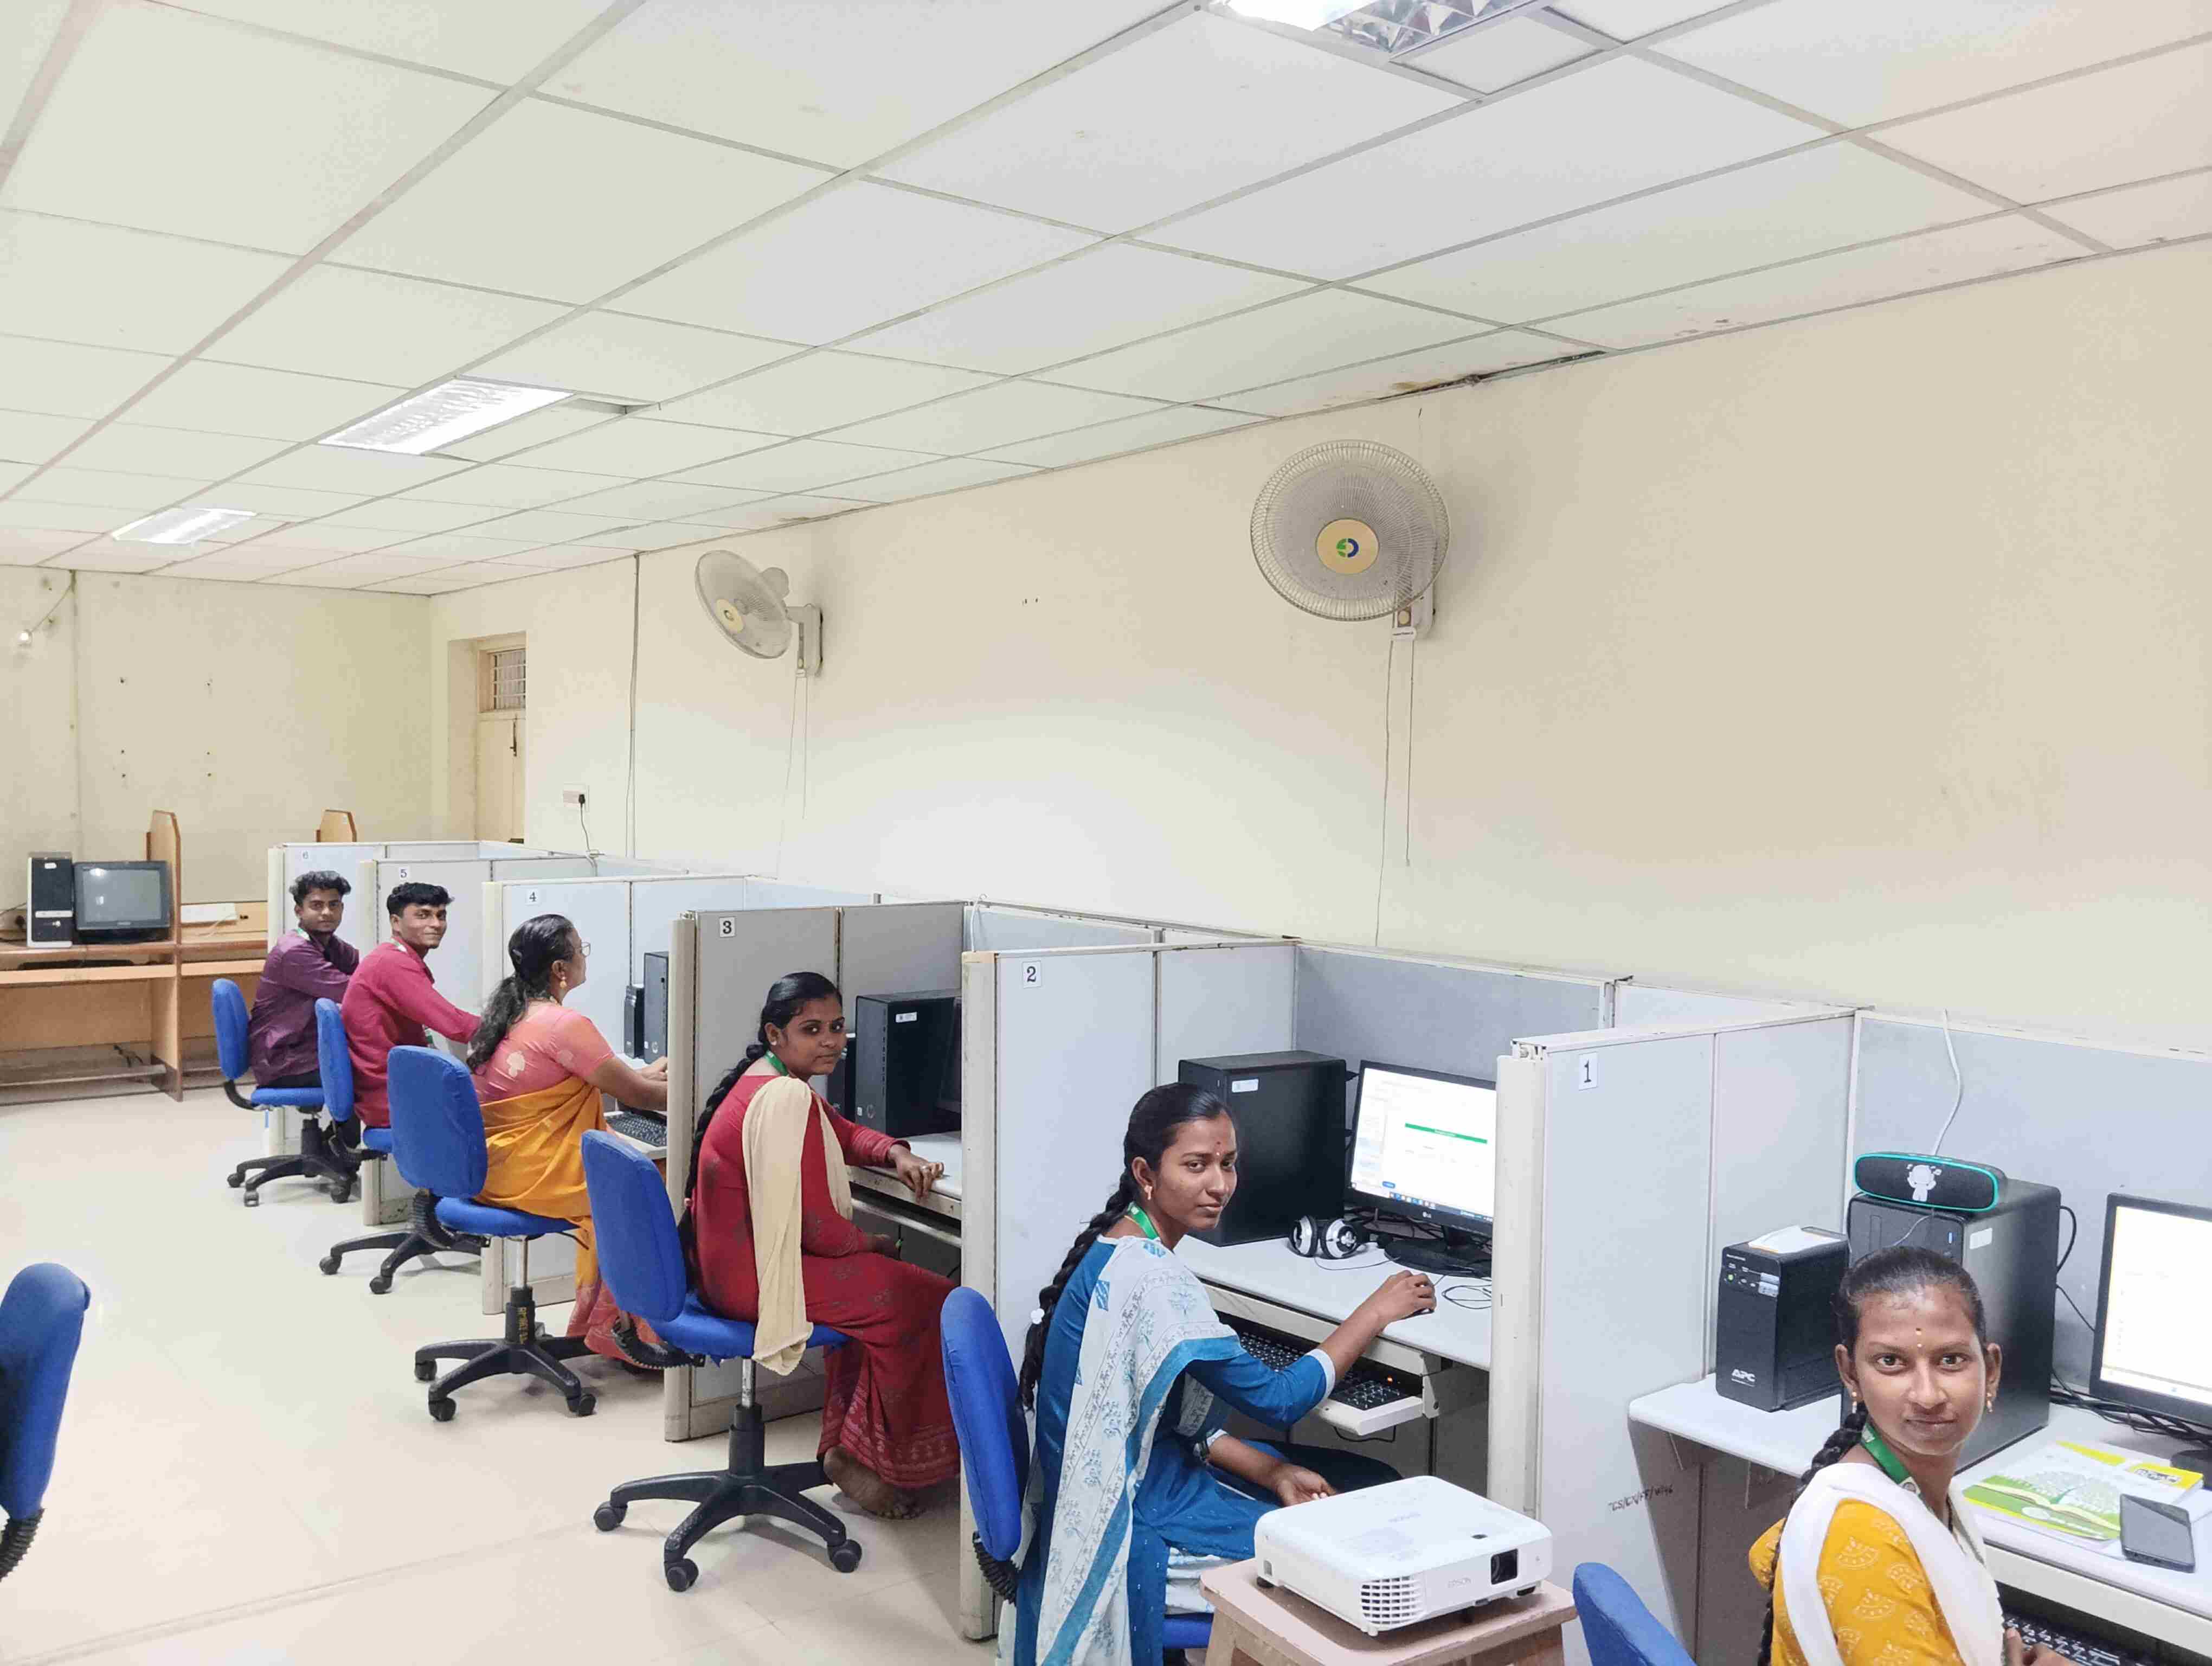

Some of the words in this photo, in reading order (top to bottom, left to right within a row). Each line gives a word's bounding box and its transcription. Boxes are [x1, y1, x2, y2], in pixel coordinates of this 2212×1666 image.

[401, 869, 407, 877] 5
[529, 892, 537, 902] 4
[723, 920, 731, 934] 3
[1027, 966, 1036, 982] 2
[1584, 1060, 1592, 1083] 1
[1732, 1369, 1756, 1382] APC
